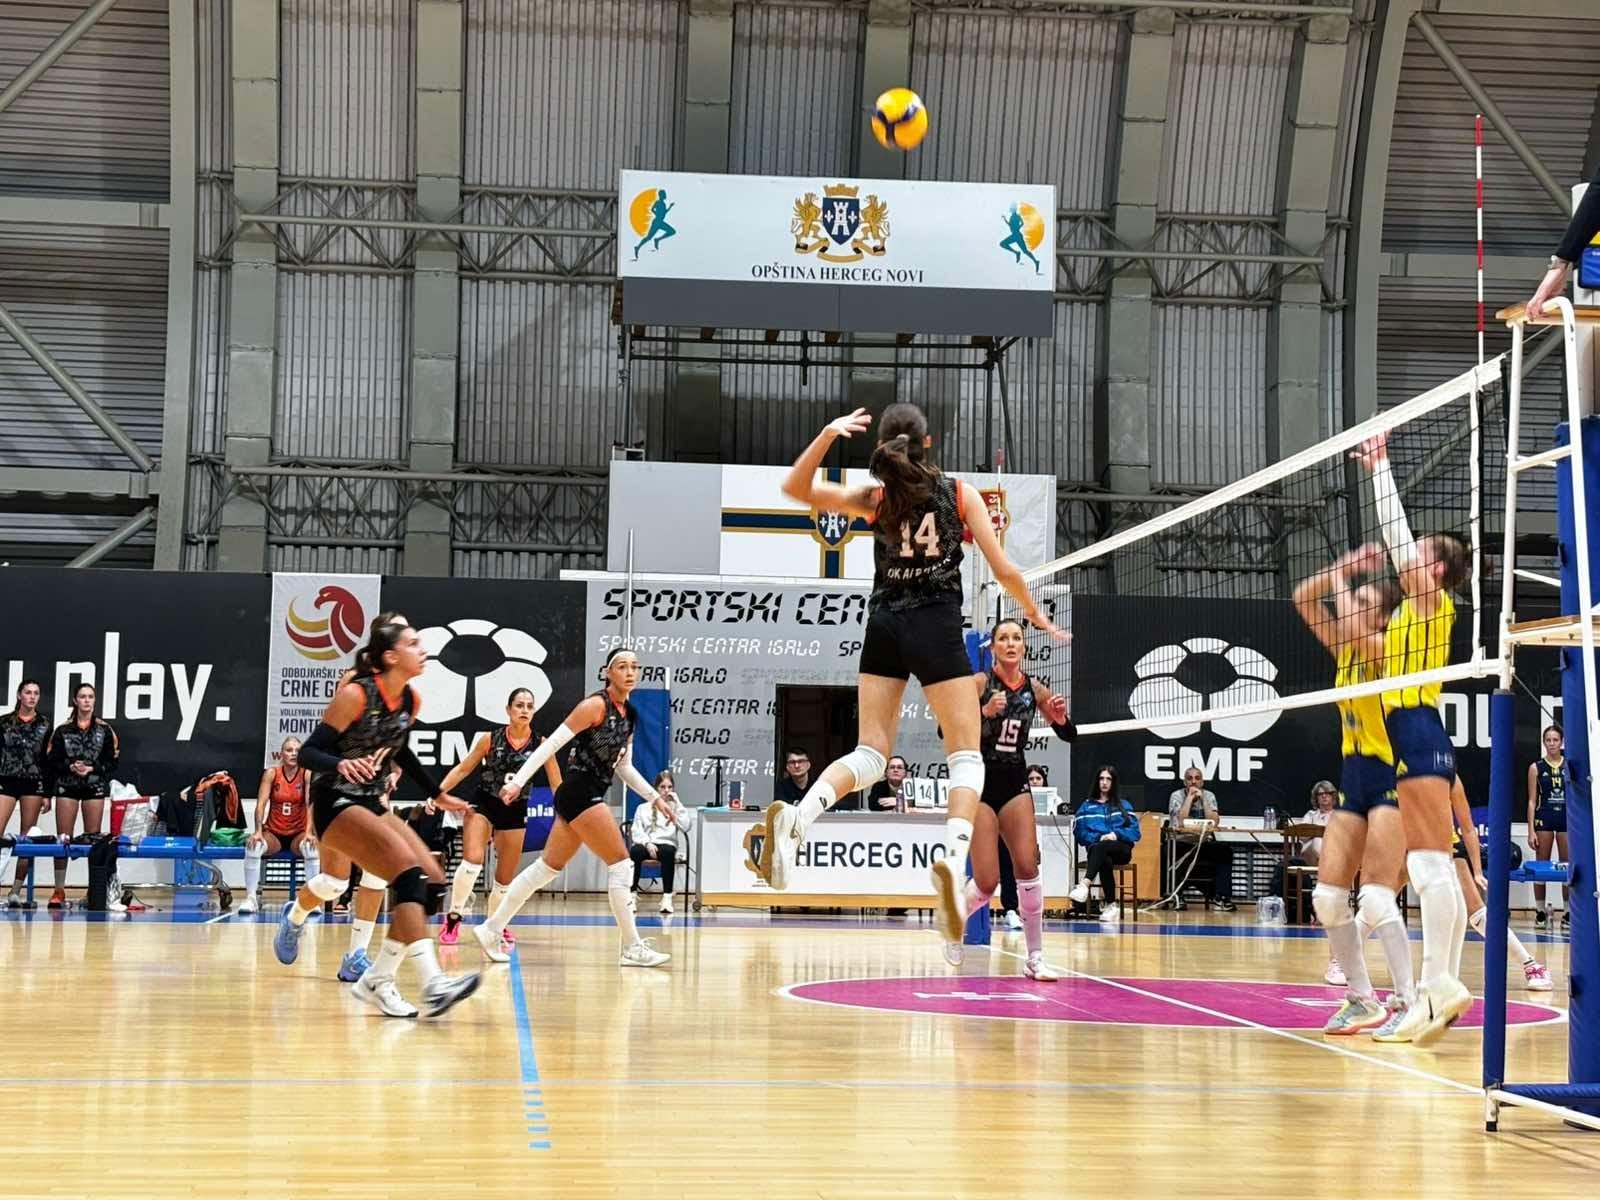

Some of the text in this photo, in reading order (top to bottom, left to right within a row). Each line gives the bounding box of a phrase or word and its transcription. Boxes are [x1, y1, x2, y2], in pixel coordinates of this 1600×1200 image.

[751, 262, 924, 283] OPŠTINA HERCEG NOVI
[899, 512, 940, 557] 14
[601, 588, 867, 625] SPORTSKI CEN
[598, 635, 688, 654] SPORTSKI
[693, 637, 760, 655] CENTAR
[767, 640, 821, 656] IGALO
[281, 667, 336, 679] ODBOJKAŠKI
[673, 667, 728, 684] IGALO
[53, 632, 231, 741] play.
[281, 680, 320, 698] CRNE
[280, 708, 316, 717] VOLLEYBALL
[690, 698, 760, 715] CENTAR
[674, 728, 731, 744] IGALO
[997, 718, 1021, 744] 15
[408, 730, 491, 766] EM
[1144, 745, 1268, 782] EMF
[282, 802, 292, 816] 6
[796, 841, 946, 868] HERCEG NO
